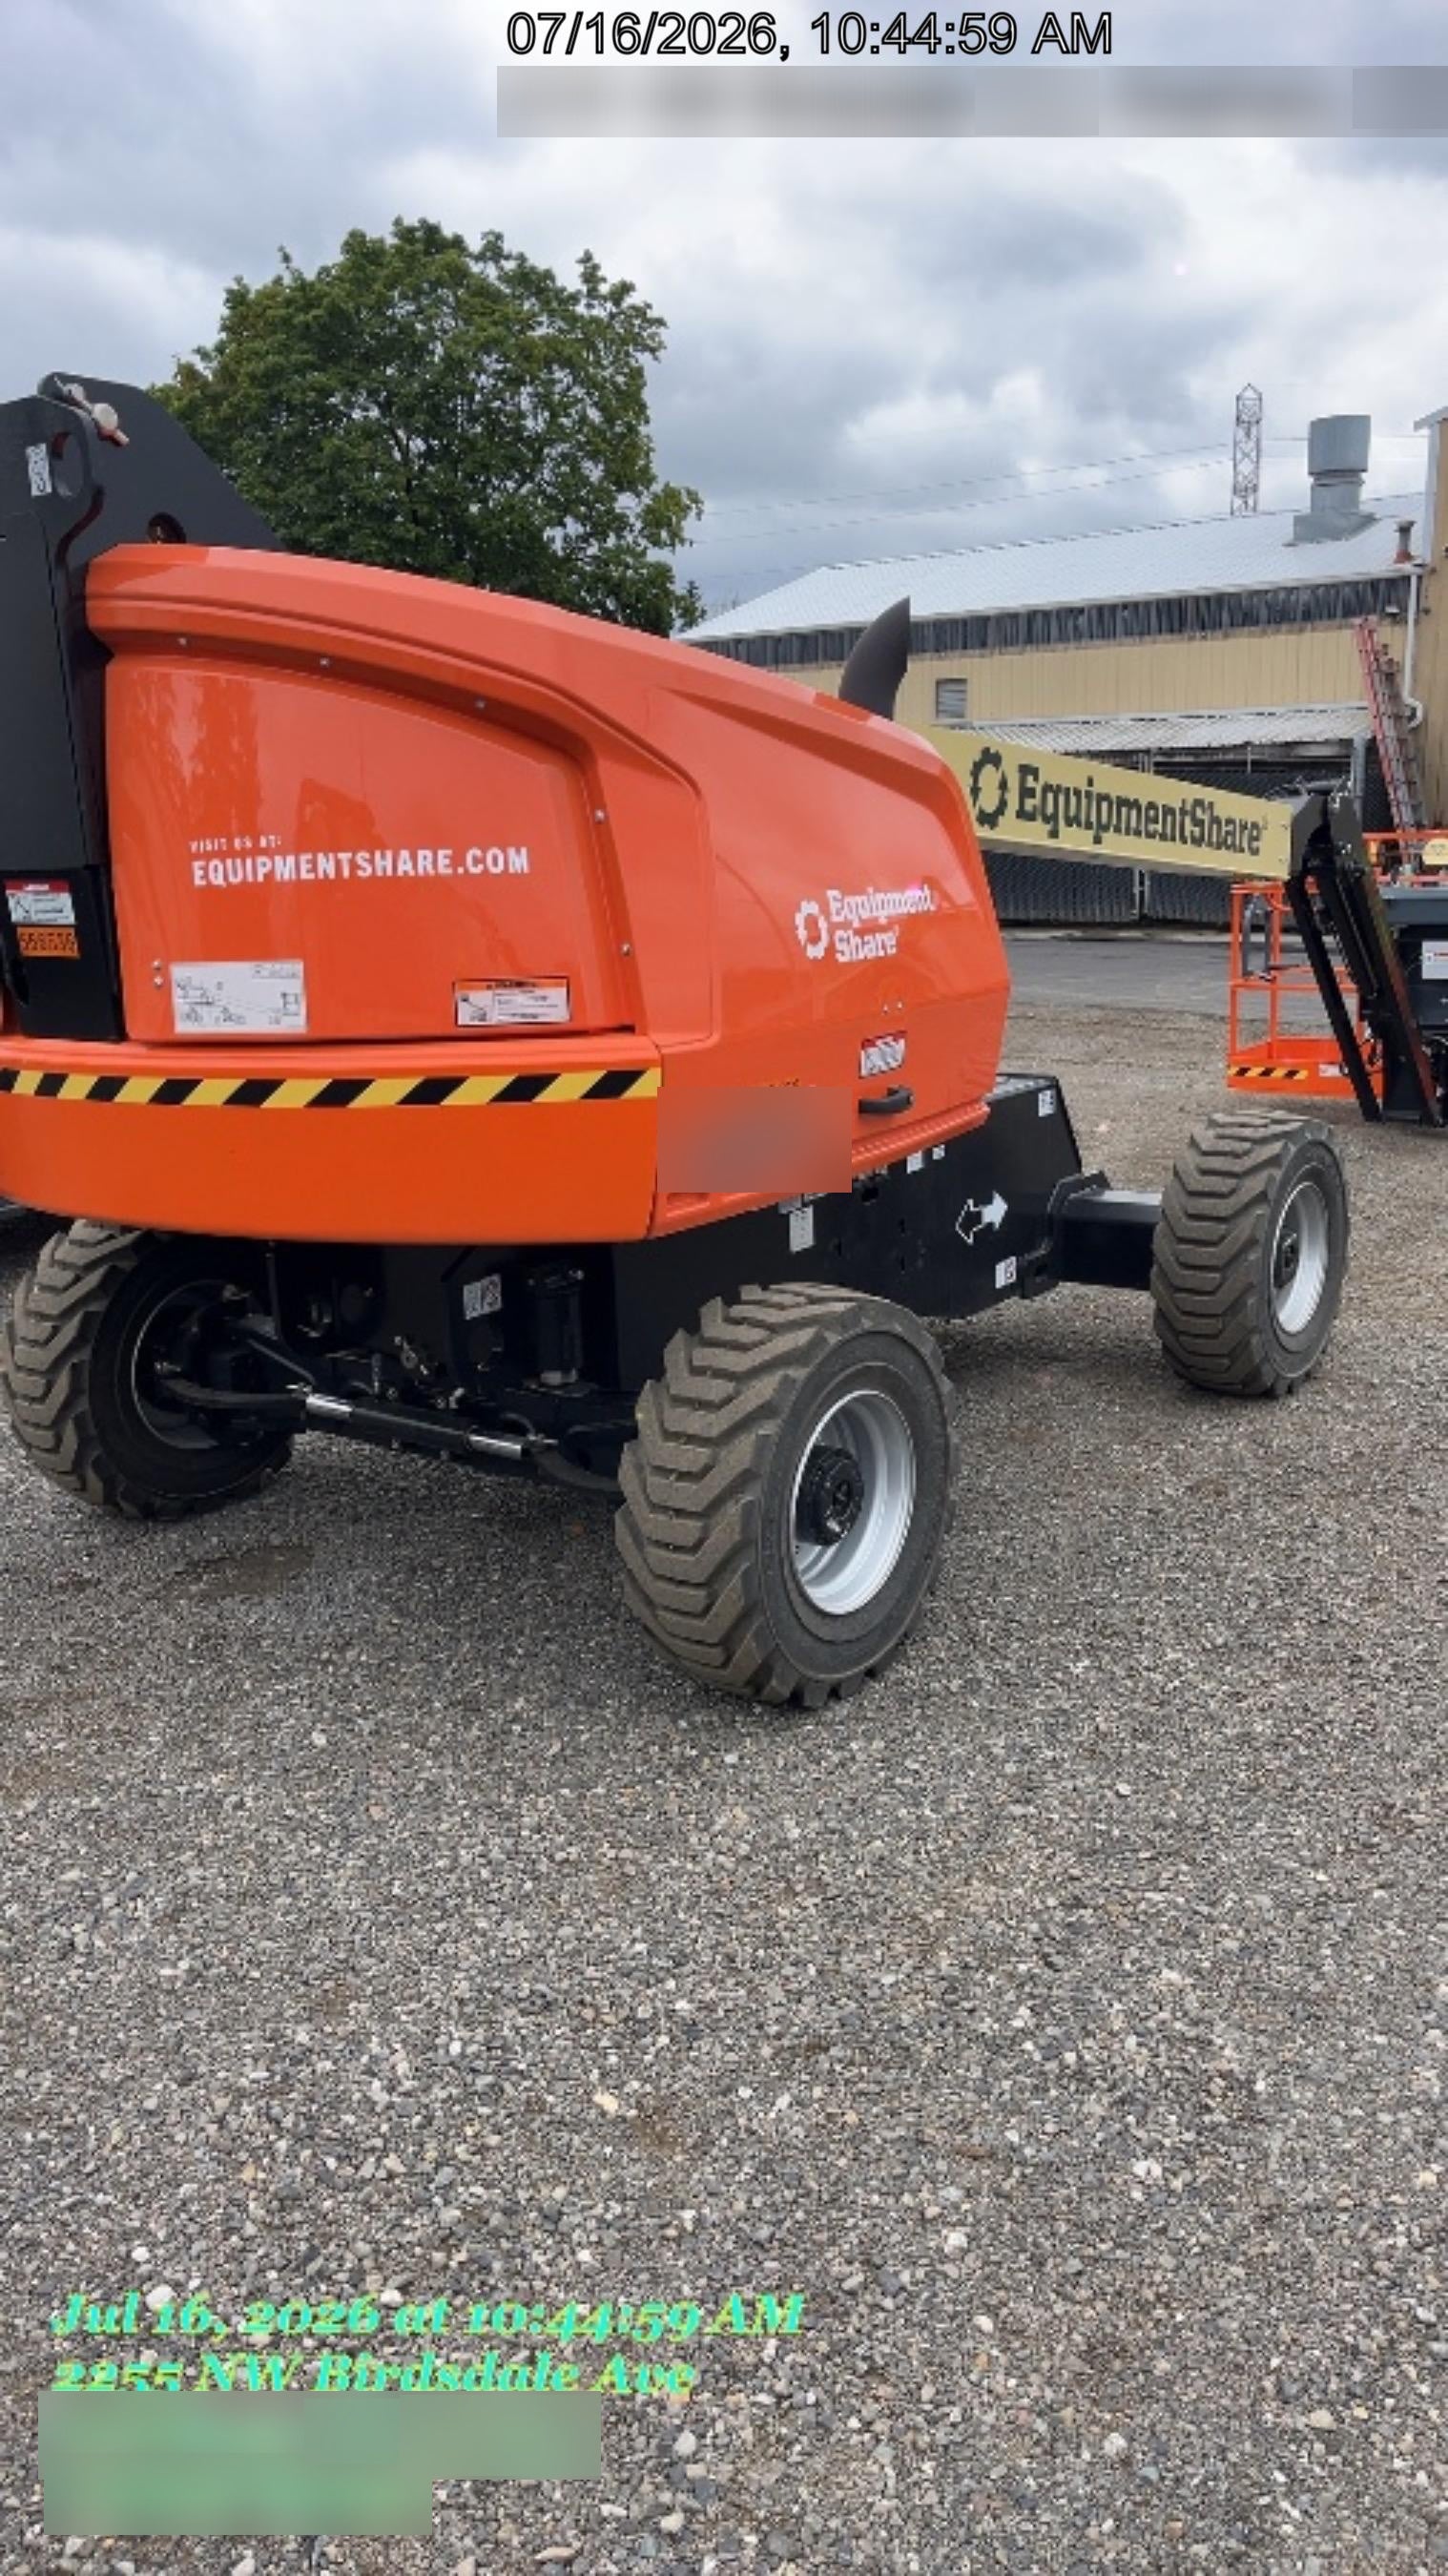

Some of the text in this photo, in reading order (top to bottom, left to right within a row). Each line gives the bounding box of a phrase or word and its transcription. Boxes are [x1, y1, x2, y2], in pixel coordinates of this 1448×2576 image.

[1015, 763, 1262, 857] EquipmentShare
[192, 846, 530, 888] EQUIPMENTSHARE.COM
[826, 884, 936, 927] Equipment
[835, 928, 897, 963] Share
